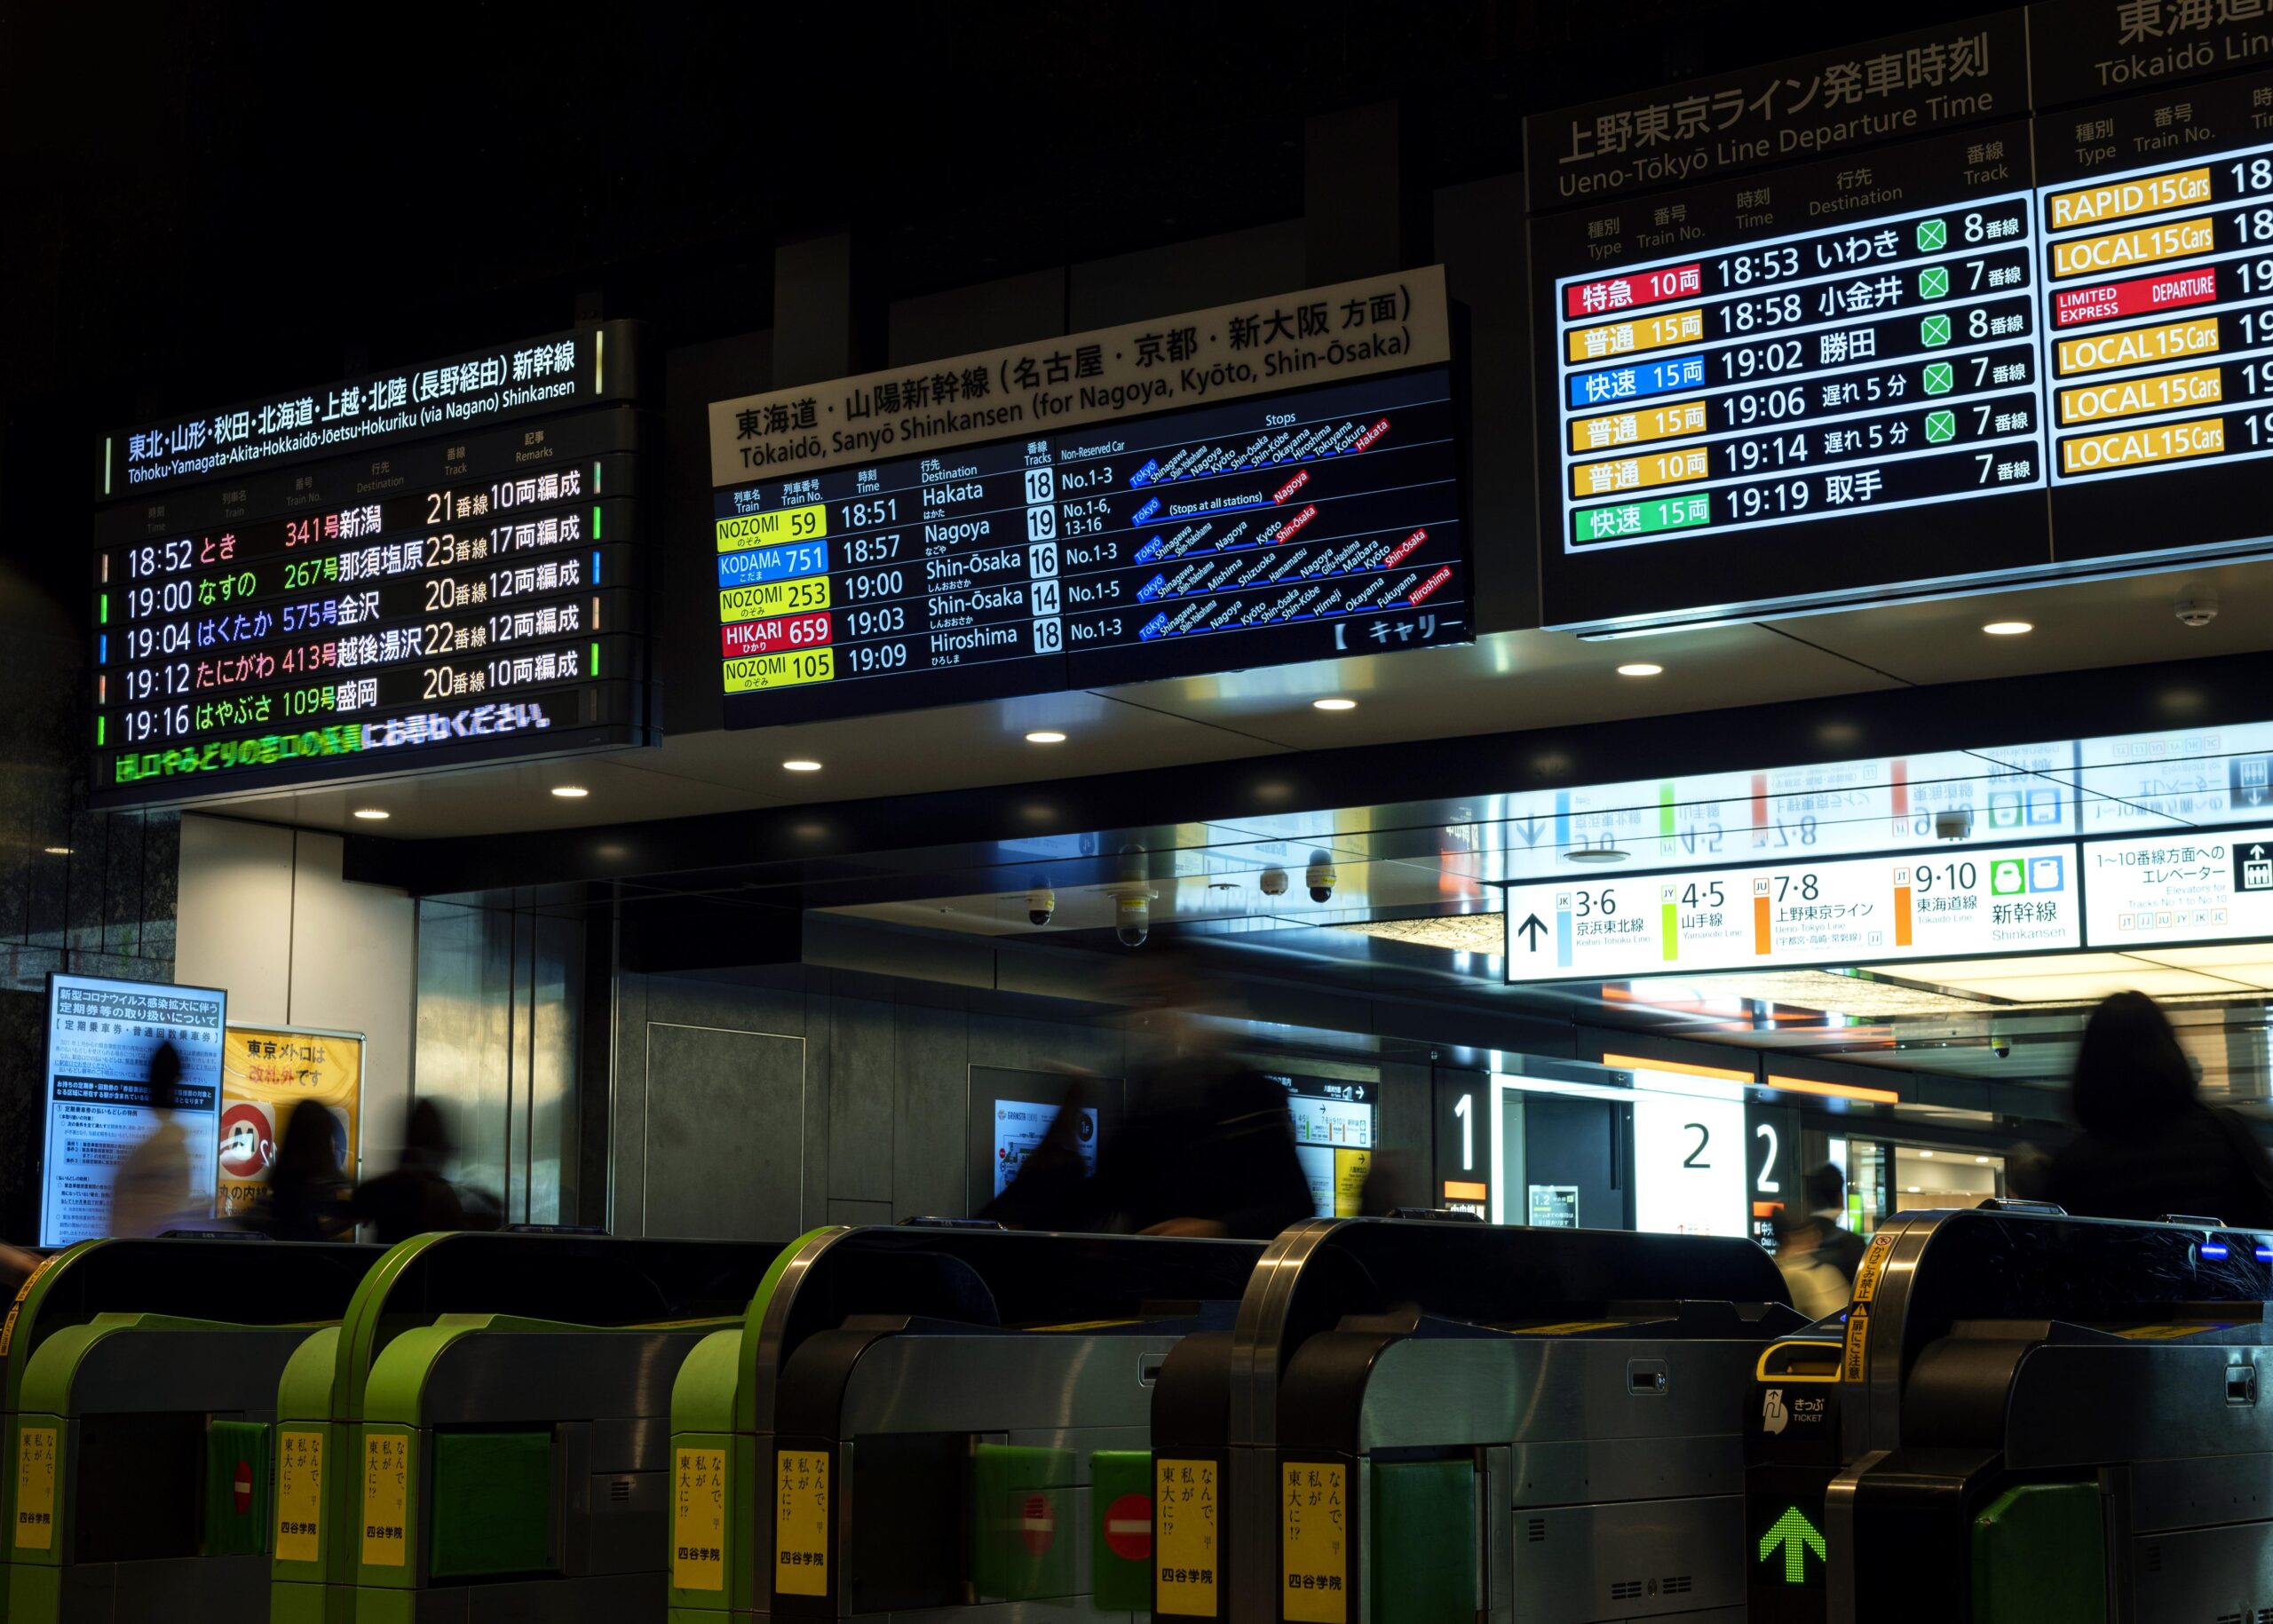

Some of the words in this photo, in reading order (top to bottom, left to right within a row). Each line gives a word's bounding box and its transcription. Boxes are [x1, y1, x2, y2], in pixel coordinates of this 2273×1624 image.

[1559, 32, 1988, 163] 上野東京ライン発車時刻
[1718, 139, 1770, 165] Line
[1780, 108, 1917, 153] Departure
[1926, 92, 1992, 121] Time
[1968, 141, 2003, 164] 番線
[1837, 169, 1872, 191] 行先
[1964, 164, 2008, 186] Track
[1810, 186, 1902, 216] Destination
[2055, 185, 2143, 223] RAPID
[1583, 281, 1633, 312] 特急
[1718, 248, 1798, 287] 18:53
[1817, 230, 1899, 269] いわき
[2057, 235, 2148, 272] LOCAL
[2059, 288, 2117, 308] LIMITED
[2152, 275, 2214, 303] DEPARTURE
[1585, 324, 1635, 356] 普通
[1720, 294, 1801, 332] 18:58
[1818, 275, 1903, 316] 小金井
[2061, 303, 2119, 322] EXPRESS
[1586, 369, 1636, 401] 快速
[1722, 341, 1803, 378] 19:02
[1820, 329, 1875, 364] 勝田
[2062, 335, 2153, 370] LOCAL
[421, 405, 441, 426] (via
[447, 392, 499, 420] Nagano)
[503, 381, 574, 408] Shinkansen
[741, 435, 827, 469] Tōkaidō,
[832, 423, 895, 455] Sanyō
[900, 403, 1023, 441] Shinkansen
[1033, 392, 1073, 419] (for
[1081, 376, 1174, 411] Nagoya,
[1181, 361, 1257, 395] Kyōto,
[1264, 326, 1411, 376] Shin-Ōsaka)
[2064, 384, 2155, 419] LOCAL
[1588, 416, 1637, 448] 普通
[1723, 387, 1805, 425] 19:06
[516, 448, 553, 463] Remarks
[857, 482, 880, 494] Time
[922, 466, 978, 483] Destination
[1025, 455, 1051, 467] Tracks
[1061, 443, 1111, 460] Non-Reserved
[1113, 441, 1125, 451] Car
[1266, 412, 1296, 426] Stops
[1150, 449, 1187, 484] Shinagawa
[1190, 447, 1222, 477] Nagoya
[1272, 428, 1310, 463] Okayama
[1313, 421, 1352, 457] Tokuyama
[1334, 425, 1366, 454] Kokura
[1356, 420, 1388, 450] Hakata
[1589, 460, 1640, 493] 普通
[1725, 434, 1808, 471] 19:14
[2067, 432, 2158, 469] LOCAL
[783, 479, 820, 495] 列車番号
[859, 469, 876, 482] 時刻
[922, 460, 940, 471] 行先
[719, 515, 779, 540] NOZOMI
[792, 512, 816, 535] 59
[842, 499, 896, 527] 18:51
[923, 484, 983, 506] Hakata
[1027, 472, 1050, 500] 18
[1169, 504, 1197, 516] (Stops
[1199, 503, 1208, 511] at
[1210, 499, 1221, 509] all
[1223, 492, 1263, 508] stations)
[1591, 506, 1642, 537] 快速
[1727, 481, 1809, 518] 19:19
[1826, 470, 1882, 504] 取手
[721, 551, 780, 574] KODAMA
[786, 547, 822, 572] 751
[843, 535, 900, 564] 18:57
[925, 520, 990, 544] Nagoya
[1029, 509, 1052, 537] 19
[1065, 518, 1102, 535] 13-16
[130, 540, 192, 577] 18:52
[200, 534, 236, 564] とき
[129, 581, 192, 618] 19:00
[199, 572, 256, 606] なすの
[723, 586, 781, 609] NOZOMI
[788, 582, 826, 608] 253
[845, 571, 902, 599] 19:00
[926, 551, 1021, 580] Shin-Ōsaka
[1032, 547, 1055, 574] 16
[726, 622, 781, 645] HIKARI
[789, 618, 828, 644] 659
[847, 607, 904, 636] 19:03
[1034, 584, 1057, 611] 14
[128, 622, 190, 659] 19:04
[198, 611, 273, 646] はくたか
[726, 657, 786, 679] NOZOMI
[793, 654, 829, 678] 105
[849, 644, 907, 672] 19:09
[931, 628, 1017, 654] Hiroshima
[1035, 622, 1059, 648] 18
[743, 642, 766, 652] ひかり
[127, 663, 189, 700] 19:12
[196, 653, 274, 688] たにがわ
[932, 654, 960, 666] ひろしま
[126, 705, 188, 741] 19:16
[196, 694, 272, 730] はやぶさ
[1756, 882, 1767, 891] JU
[2143, 867, 2225, 883] エレベーター
[2166, 885, 2210, 894] Elevators
[1682, 913, 1723, 929] 山手線
[1776, 904, 1873, 922] 上野東京ライン
[1917, 895, 1977, 912] 東海道線
[1992, 901, 2056, 924] 新幹線
[1577, 918, 1643, 936] 京浜東北線
[1992, 928, 2065, 941] Shinkansen
[59, 1002, 217, 1026] 定期券等の取り扱いについて
[60, 988, 218, 1013] 新型コロナウイルス感染拡大に伴う
[247, 1040, 325, 1064] 東京メトロは
[1454, 1094, 1473, 1170] 1
[1683, 1123, 1710, 1168] 2
[1757, 1124, 1778, 1192] 2
[1858, 1247, 1884, 1299] かけこみ禁止
[1849, 1319, 1865, 1379] 扉にご注意
[1794, 1399, 1825, 1411] きっぷ
[695, 1456, 707, 1486] 私が
[1308, 1471, 1322, 1505] 私が
[20, 1513, 51, 1525] 四谷学院
[281, 1522, 316, 1534] 四谷学院
[367, 1526, 402, 1539] 四谷学院
